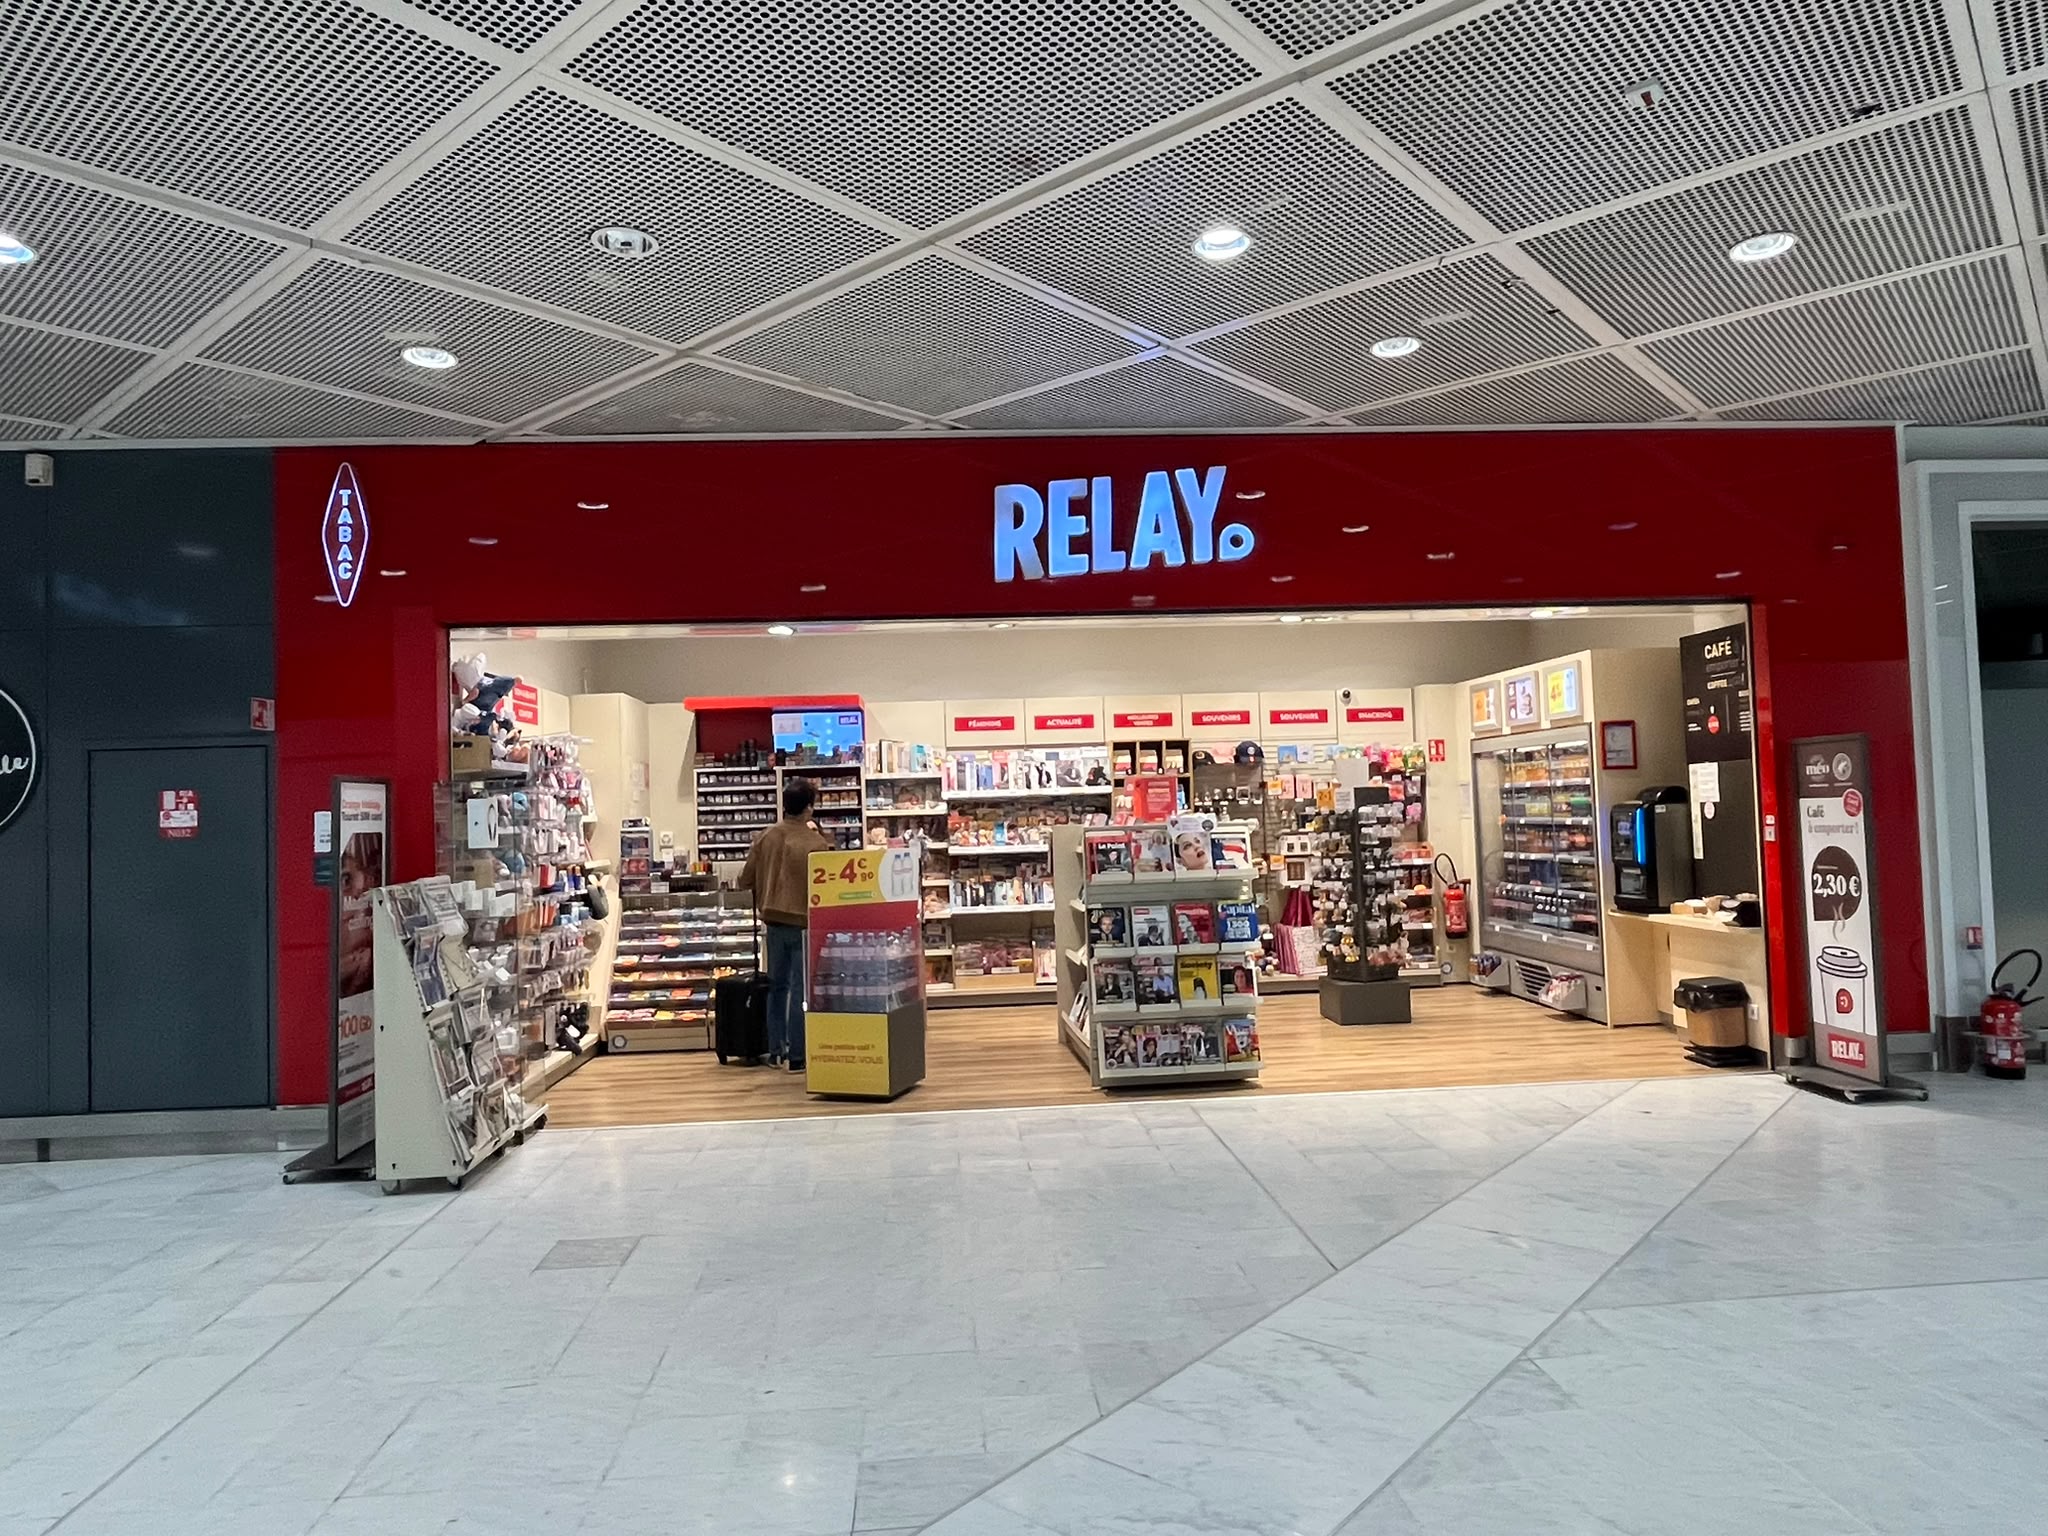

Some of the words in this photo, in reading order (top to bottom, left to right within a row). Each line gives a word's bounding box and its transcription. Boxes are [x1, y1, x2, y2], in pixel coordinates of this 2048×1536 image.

[338, 489, 353, 579] TABAC
[1704, 636, 1732, 659] CAFÉ
[1047, 717, 1083, 726] ACTUALITÉ
[1202, 713, 1241, 722] SOUVENIRS
[1280, 712, 1319, 721] SOUVENIRS
[1806, 762, 1830, 776] méo
[1807, 805, 1825, 818] Café
[1813, 873, 1848, 898] 2,30
[1849, 876, 1860, 897] €
[1218, 903, 1256, 916] Capital
